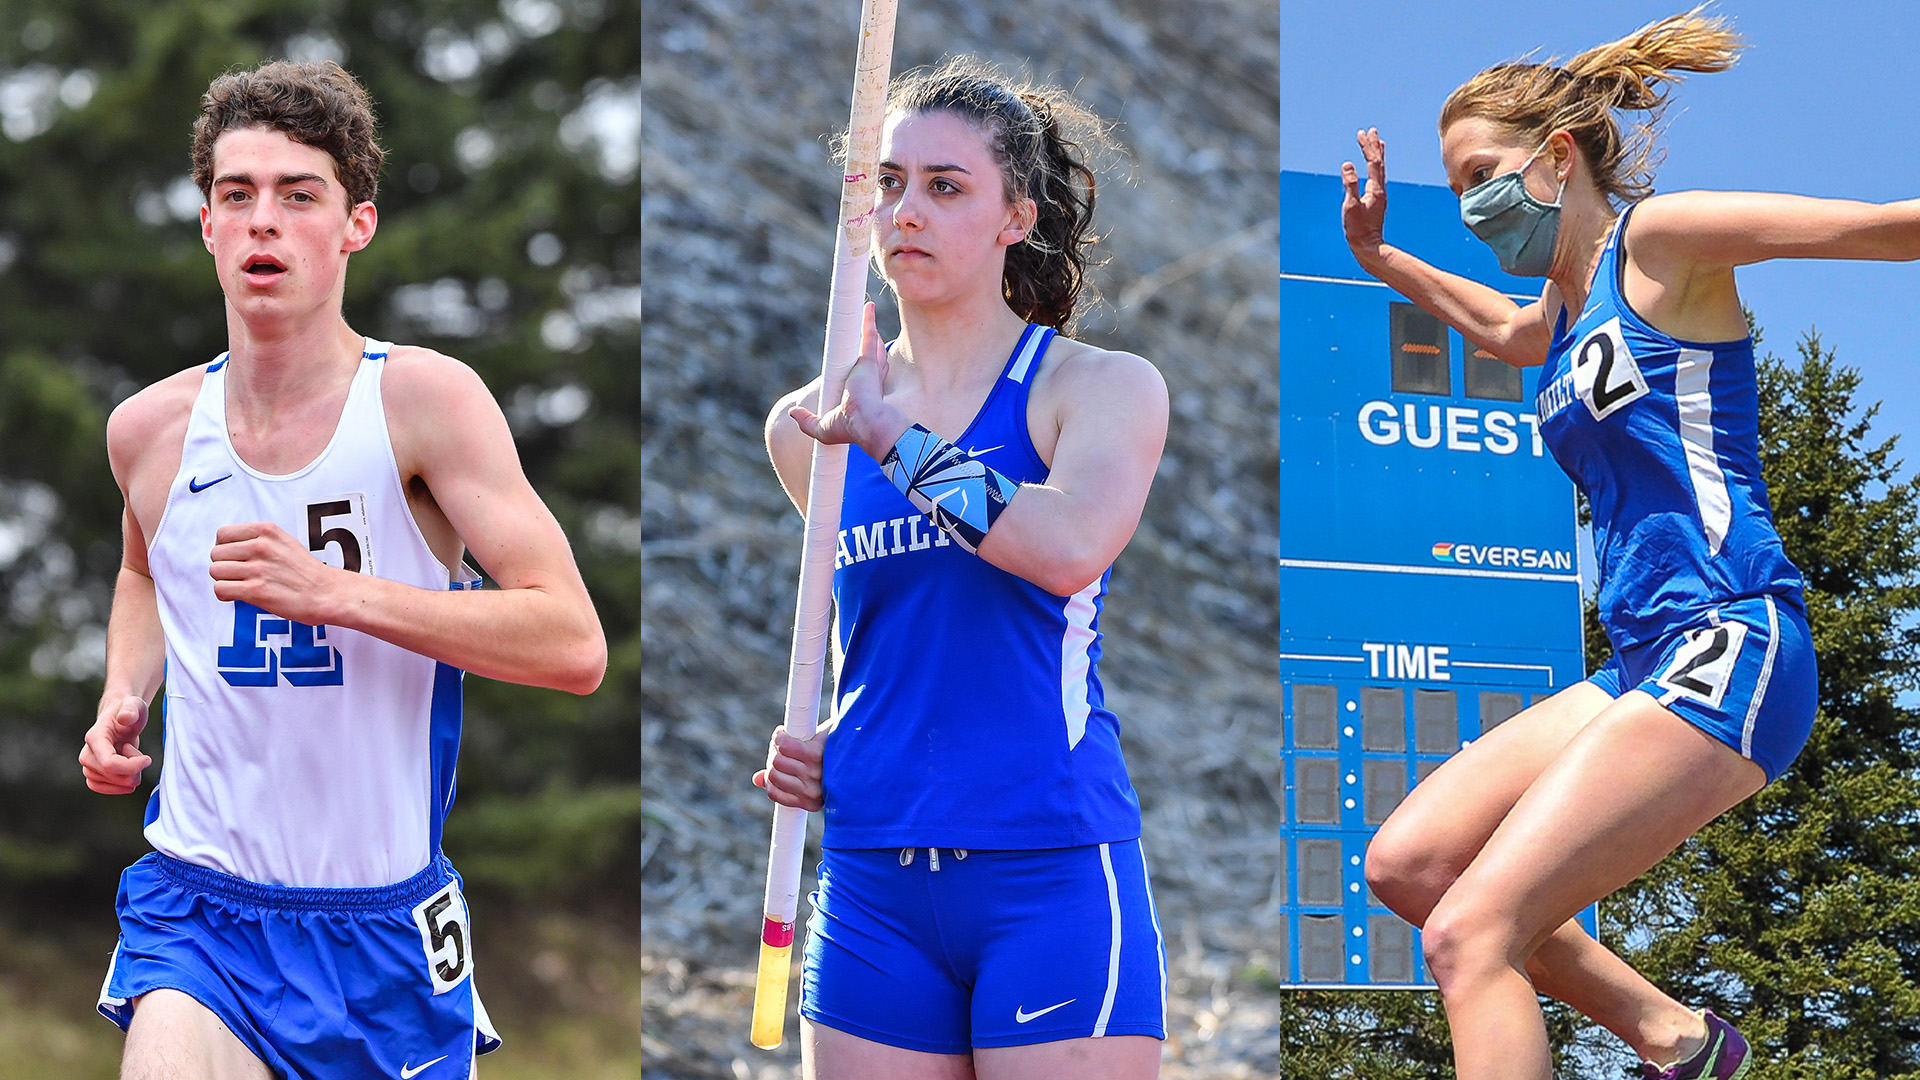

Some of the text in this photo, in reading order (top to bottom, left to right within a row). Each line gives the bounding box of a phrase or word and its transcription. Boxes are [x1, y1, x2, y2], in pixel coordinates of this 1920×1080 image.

[1578, 332, 1637, 412] 2
[1357, 400, 1545, 457] GUEST
[307, 499, 362, 574] 5
[1454, 543, 1572, 570] EVERSAN
[1362, 643, 1451, 681] TIME
[1667, 626, 1729, 697] 2
[423, 892, 465, 982] 5
